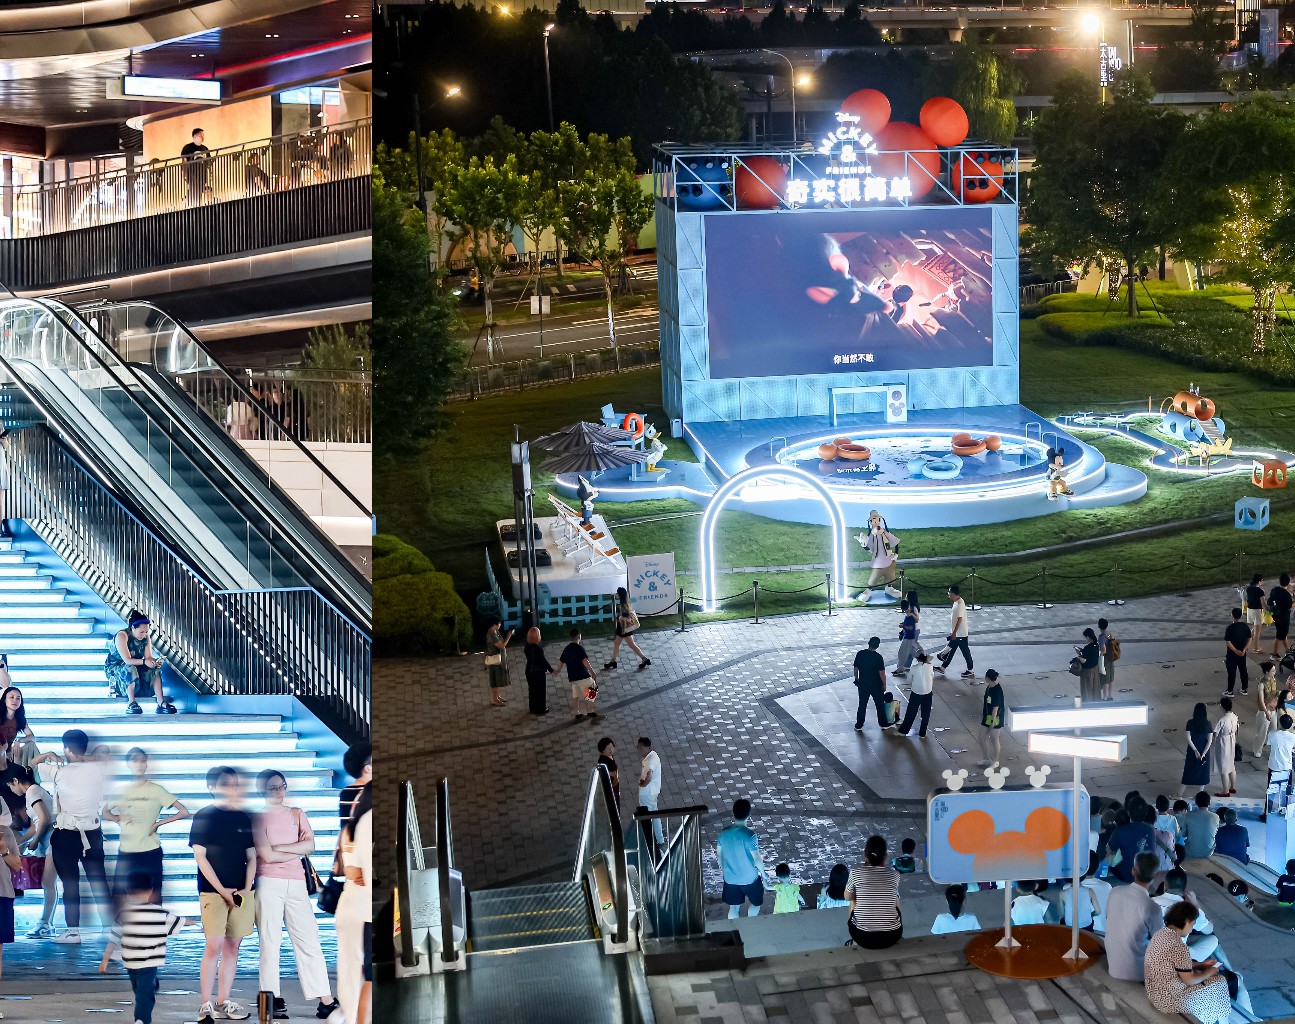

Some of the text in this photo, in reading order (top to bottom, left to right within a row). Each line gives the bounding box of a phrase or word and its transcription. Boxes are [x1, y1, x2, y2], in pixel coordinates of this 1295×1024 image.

[818, 126, 879, 156] MICKEY
[840, 144, 857, 162] &
[825, 165, 872, 175] FRIENDS
[634, 569, 672, 589] MICKEY
[648, 581, 658, 592] &
